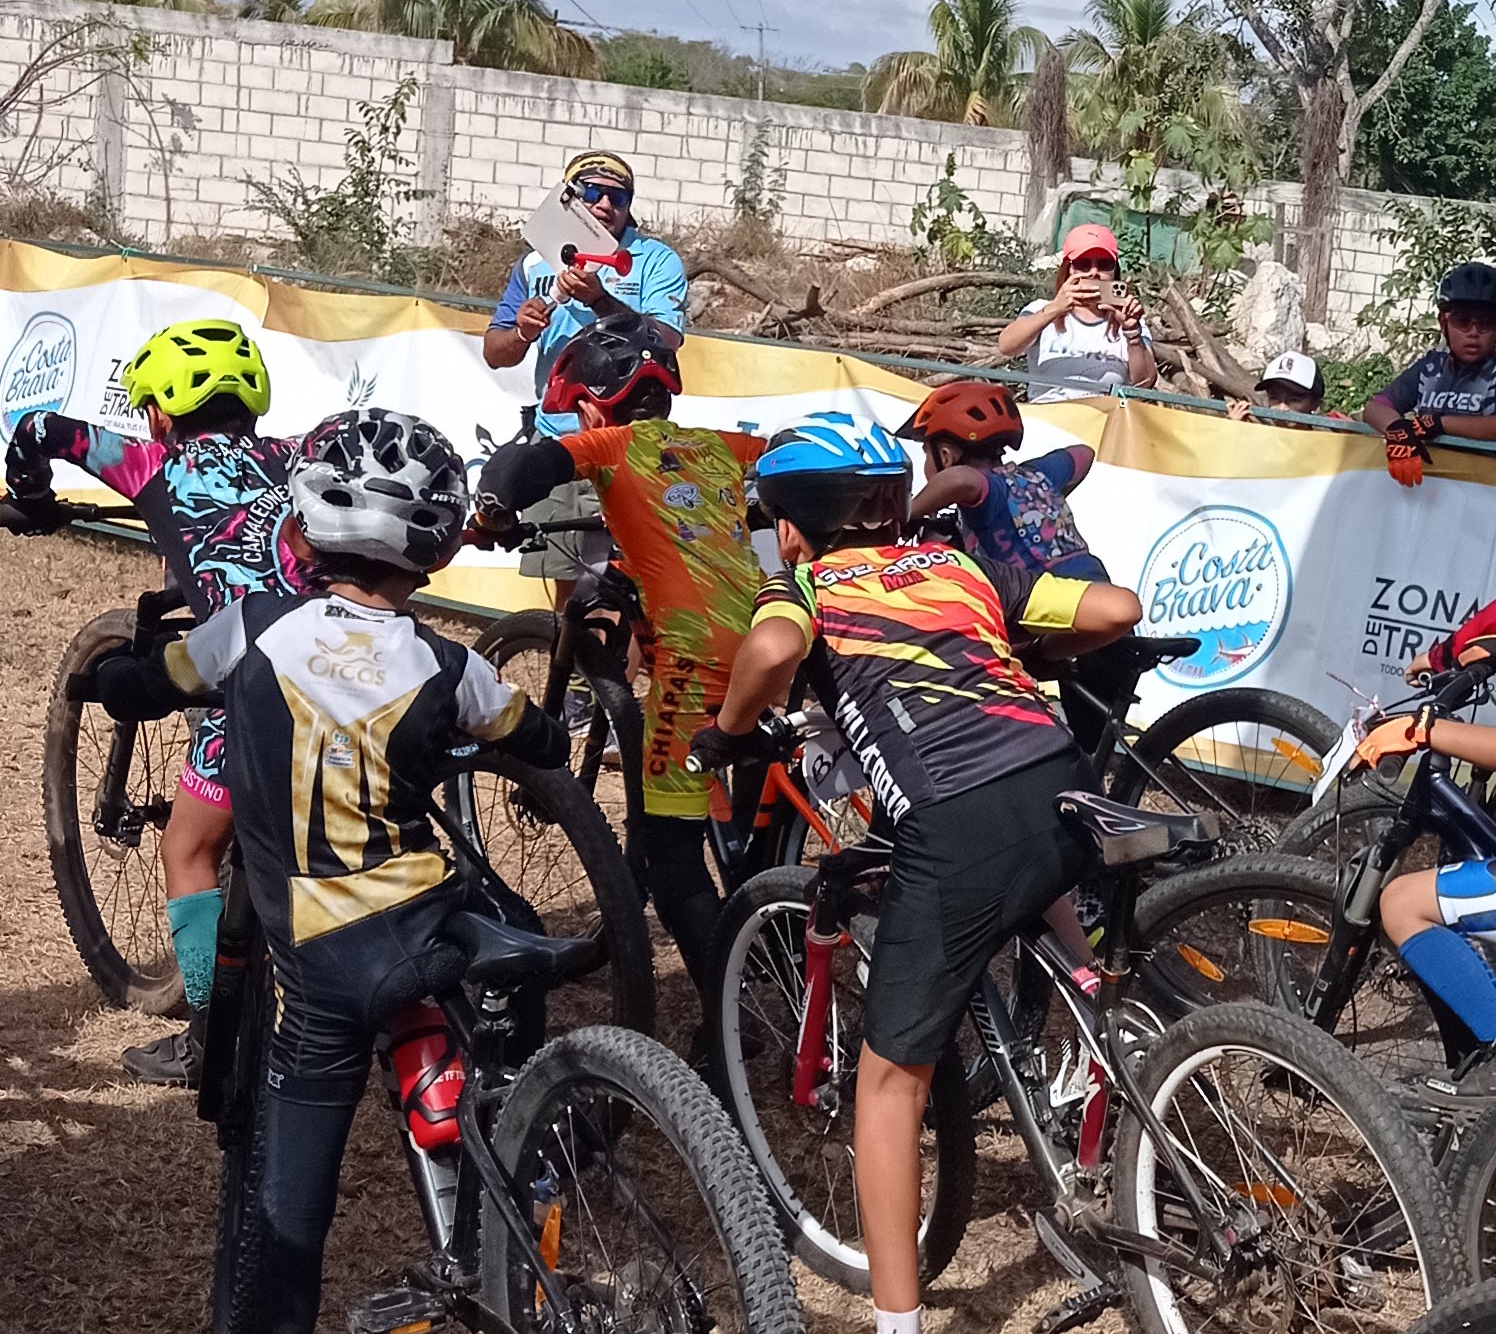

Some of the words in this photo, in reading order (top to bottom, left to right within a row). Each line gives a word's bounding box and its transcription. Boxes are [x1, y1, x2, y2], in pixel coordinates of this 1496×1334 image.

[25, 334, 72, 374] Costa
[5, 367, 60, 403] Brava
[242, 484, 290, 563] CAMALEONE
[1178, 537, 1275, 586] Costa
[1149, 576, 1254, 624] Brava
[307, 654, 386, 686] Orcas
[650, 657, 696, 776] CHIAPAS
